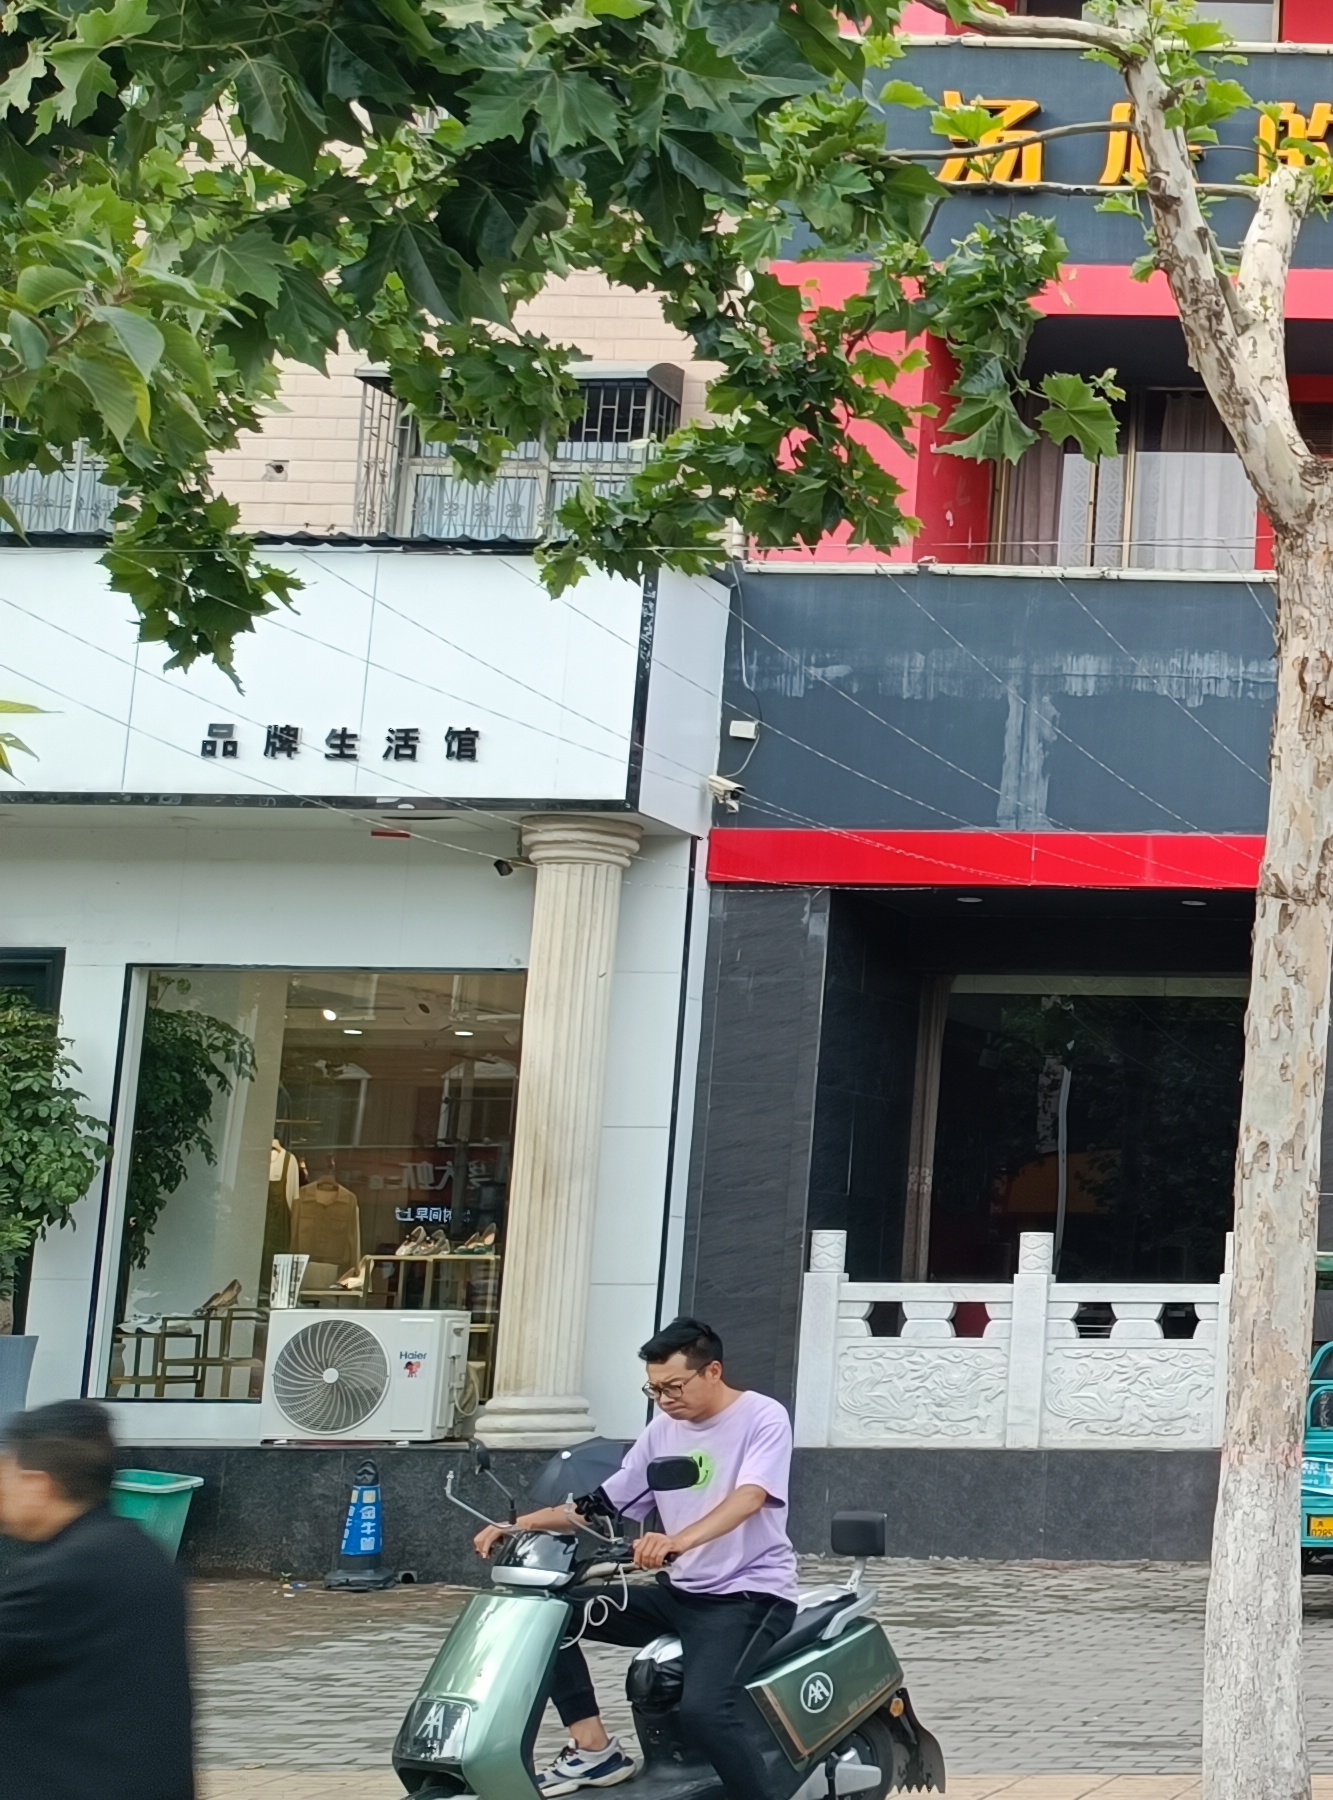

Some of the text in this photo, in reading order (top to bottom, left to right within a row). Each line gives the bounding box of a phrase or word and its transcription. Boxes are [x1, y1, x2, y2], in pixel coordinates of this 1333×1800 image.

[200, 724, 481, 761] 品牌生活馆
[399, 1351, 427, 1360] Haier
